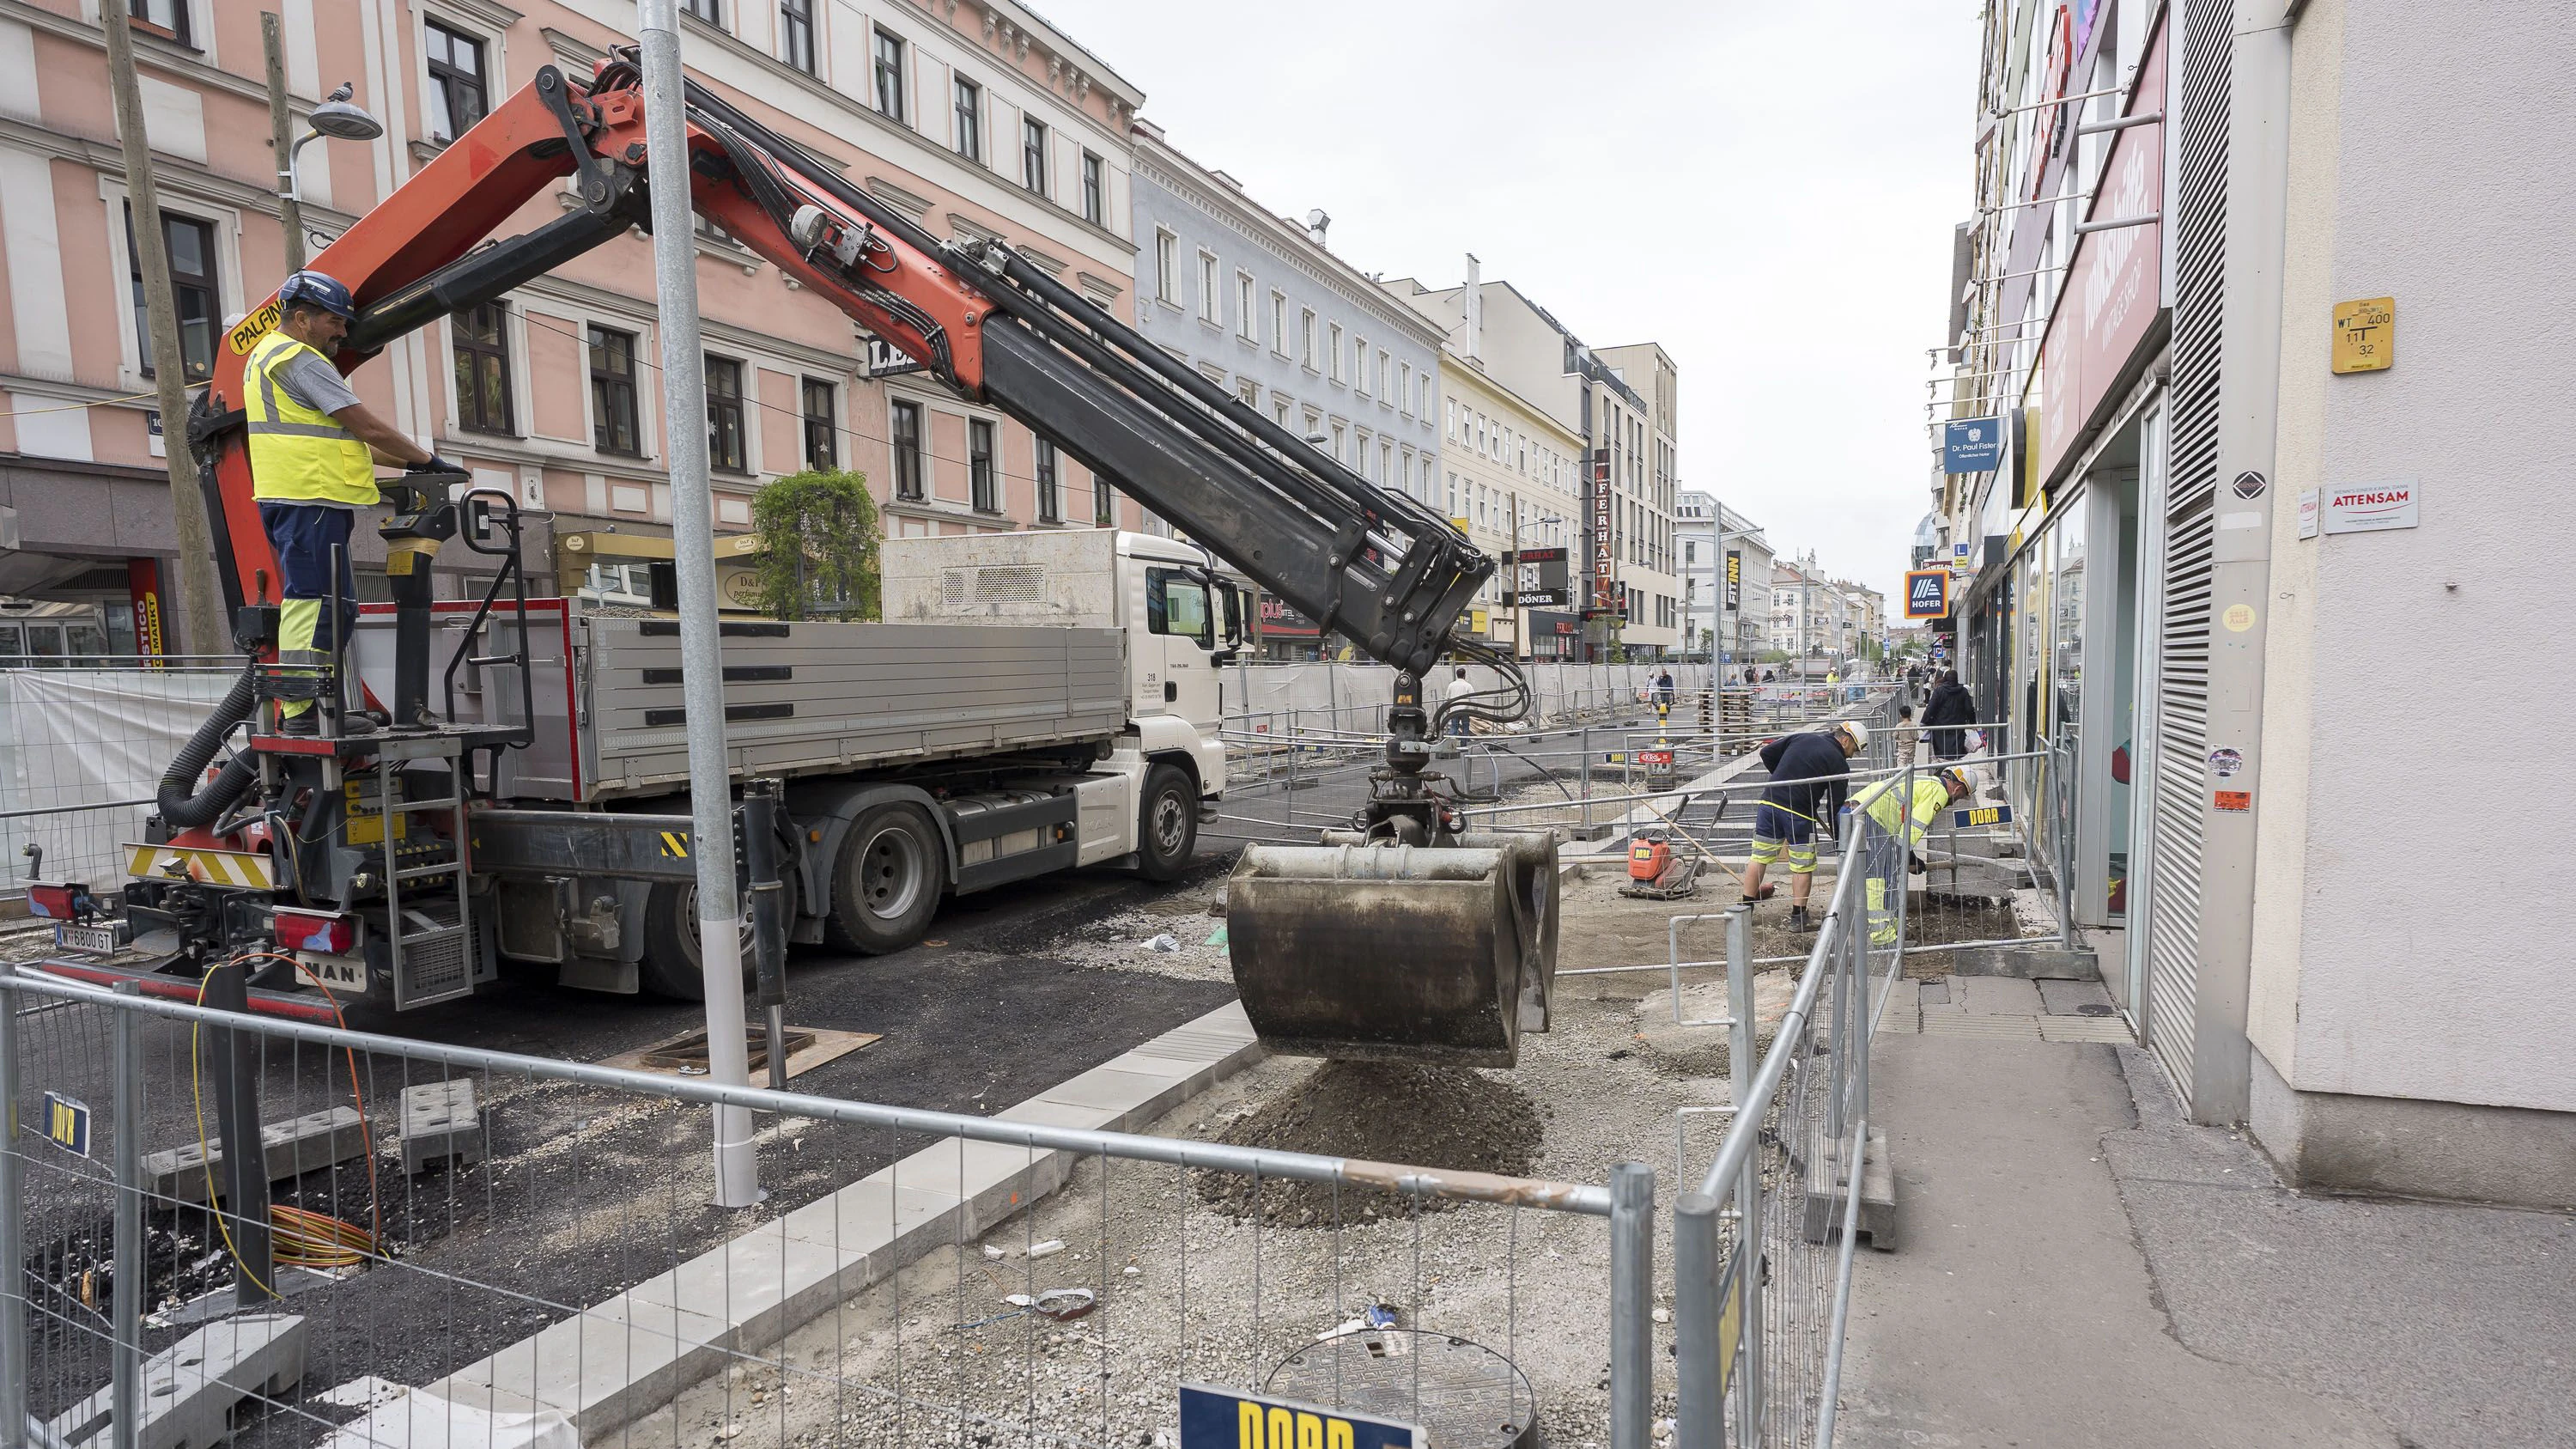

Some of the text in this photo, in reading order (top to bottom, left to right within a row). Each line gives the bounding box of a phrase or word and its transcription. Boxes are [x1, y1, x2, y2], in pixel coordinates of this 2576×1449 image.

[234, 299, 286, 351] PALFIN
[2337, 314, 2391, 328] WT 400
[2346, 333, 2358, 343] 11
[870, 340, 917, 370] LE
[2359, 344, 2374, 356] 32
[1962, 443, 1978, 452] Paul
[2332, 490, 2409, 508] ATTENSAM
[1597, 483, 1607, 574] FERHAT
[1957, 545, 1965, 555] L
[1518, 594, 1553, 604] DÖNER
[1911, 600, 1941, 608] HOFER
[1147, 673, 1156, 681] 318
[62, 930, 110, 950] W 6800 GT
[305, 962, 355, 983] MAN
